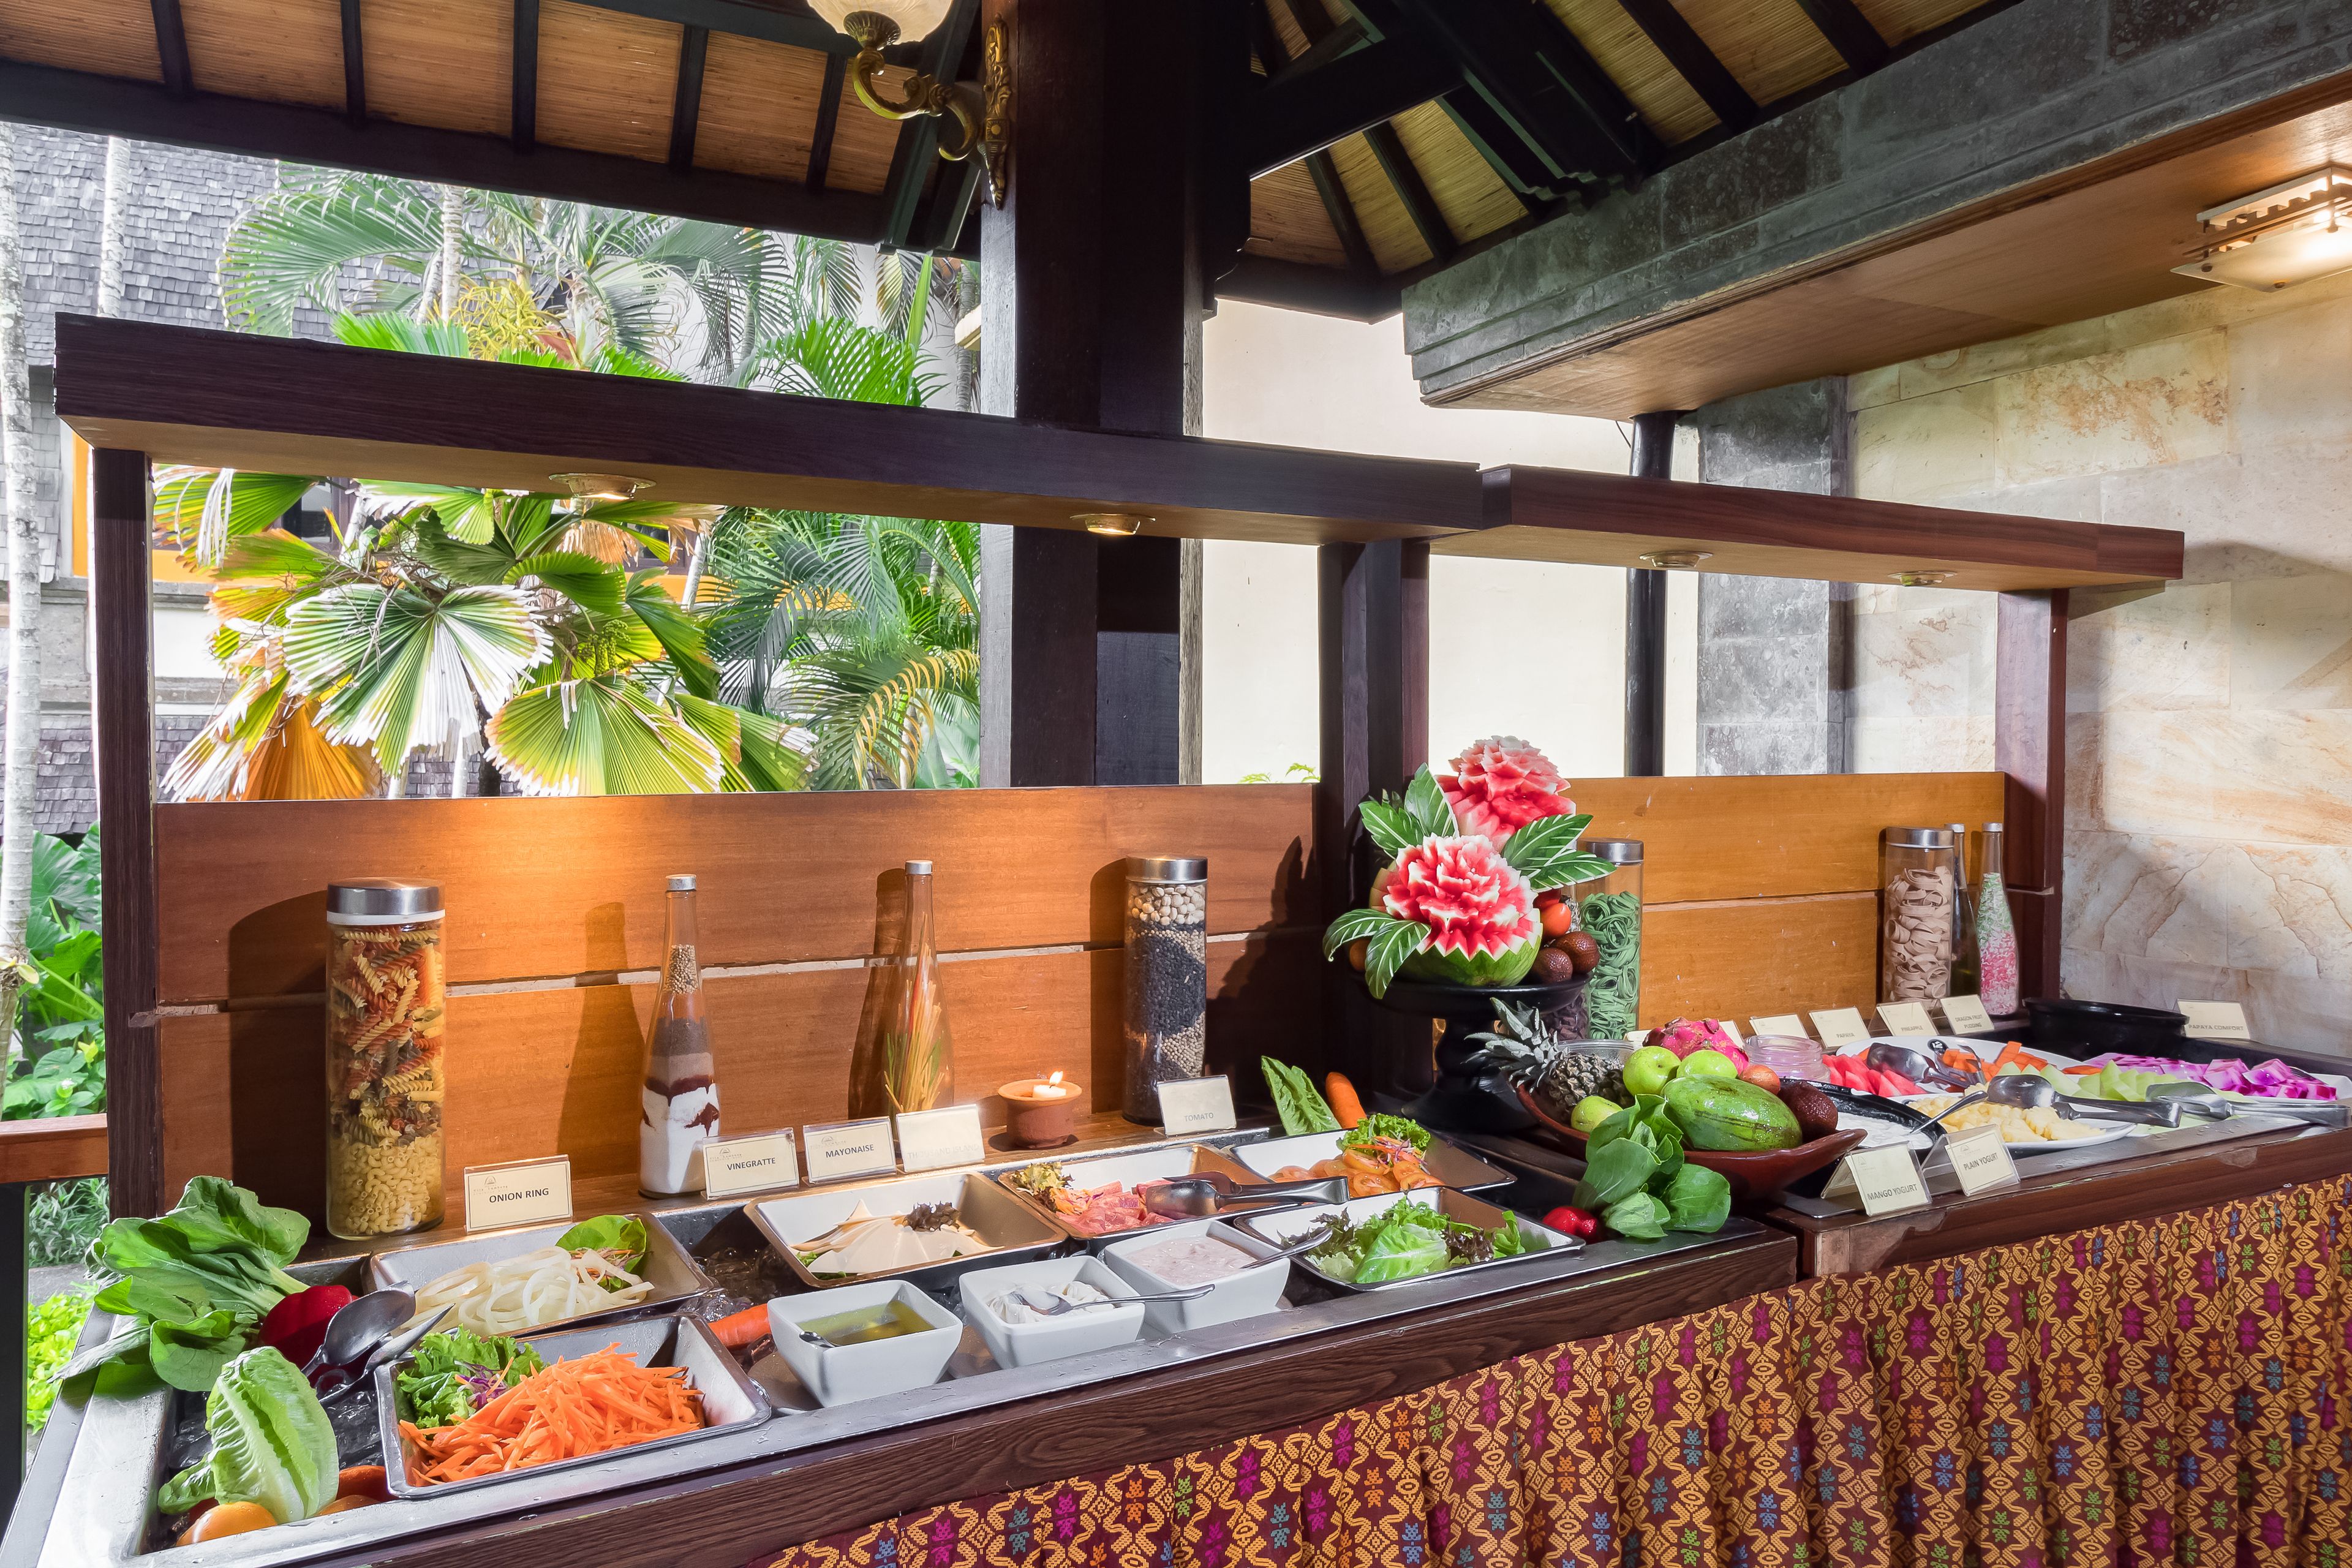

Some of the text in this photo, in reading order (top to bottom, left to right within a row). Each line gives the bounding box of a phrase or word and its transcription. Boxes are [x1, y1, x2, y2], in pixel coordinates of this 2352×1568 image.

[1184, 1112, 1214, 1122] TOMATO
[826, 1144, 875, 1158] MAYONAISE
[907, 1144, 979, 1159] THOUSAND ISLAND
[727, 1157, 776, 1170] VINEGRATTE
[1963, 1161, 1980, 1171] PLAIN
[1979, 1153, 1999, 1166] YOGURT
[489, 1188, 549, 1203] ONION RING
[1867, 1183, 1918, 1200] MANGO YOGURT
